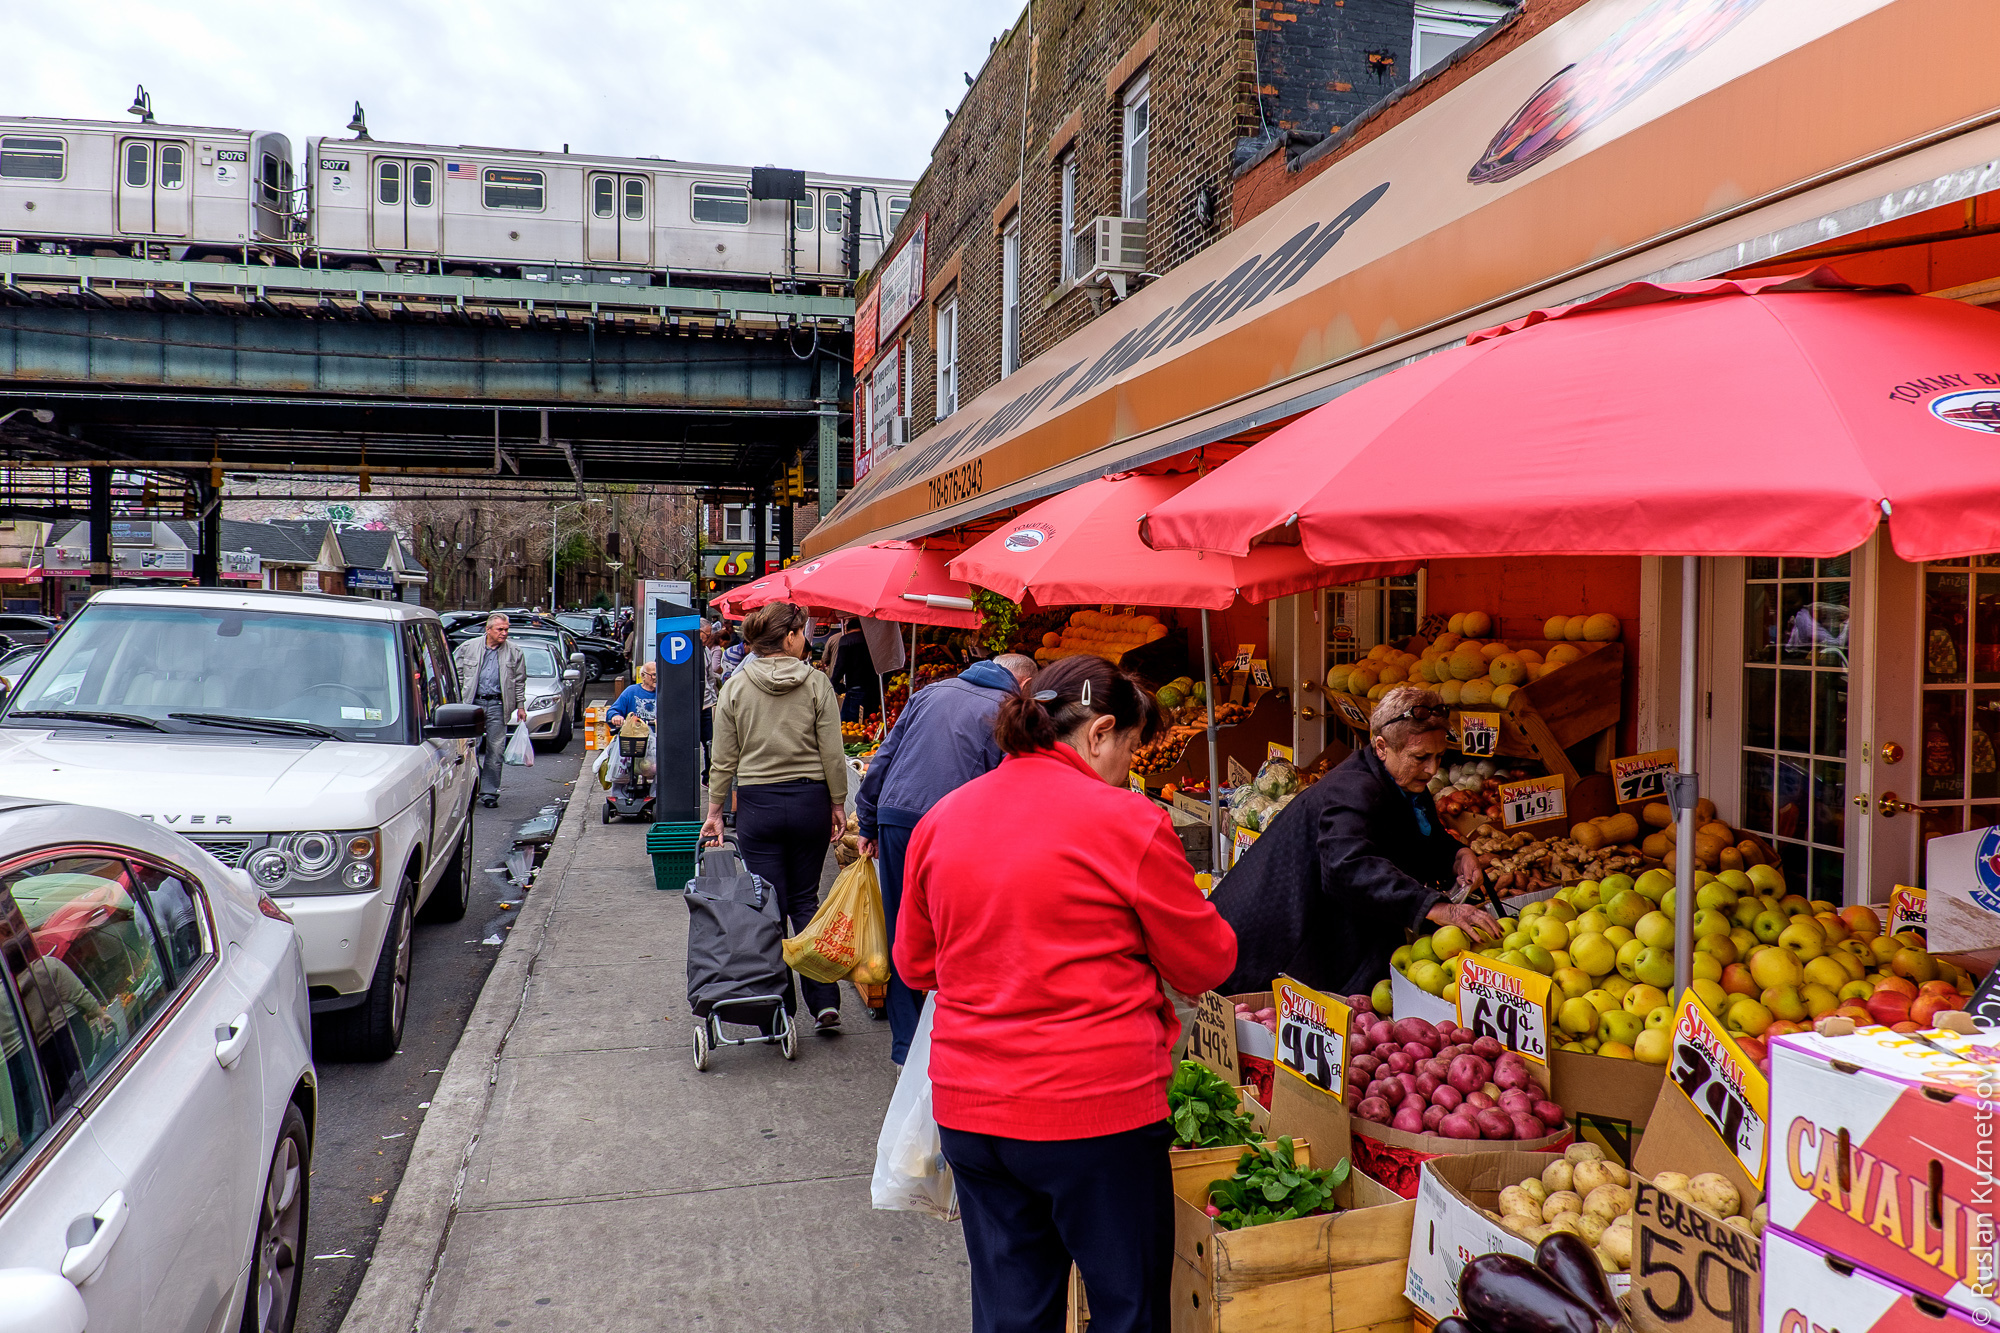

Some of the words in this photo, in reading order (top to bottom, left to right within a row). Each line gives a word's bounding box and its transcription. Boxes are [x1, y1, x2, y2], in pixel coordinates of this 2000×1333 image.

[219, 151, 246, 161] 9076
[321, 160, 348, 170] 9077
[946, 356, 1089, 464] FRUIT
[1047, 181, 1391, 412] BAZAAR
[1889, 373, 1971, 404] TOMMY
[928, 457, 984, 510] 718-676-2343
[670, 636, 687, 661] P
[1464, 731, 1490, 755] 99
[1615, 757, 1659, 779] SPECIAL
[1503, 782, 1546, 803] SPECIAL
[1460, 958, 1525, 998] SPECIAL
[1280, 984, 1328, 1024] SPECIAL
[1472, 996, 1518, 1052] 69
[1281, 1022, 1332, 1091] 99
[1678, 1001, 1747, 1095] SPECIAL
[1786, 1115, 2000, 1304] CAVALIE
